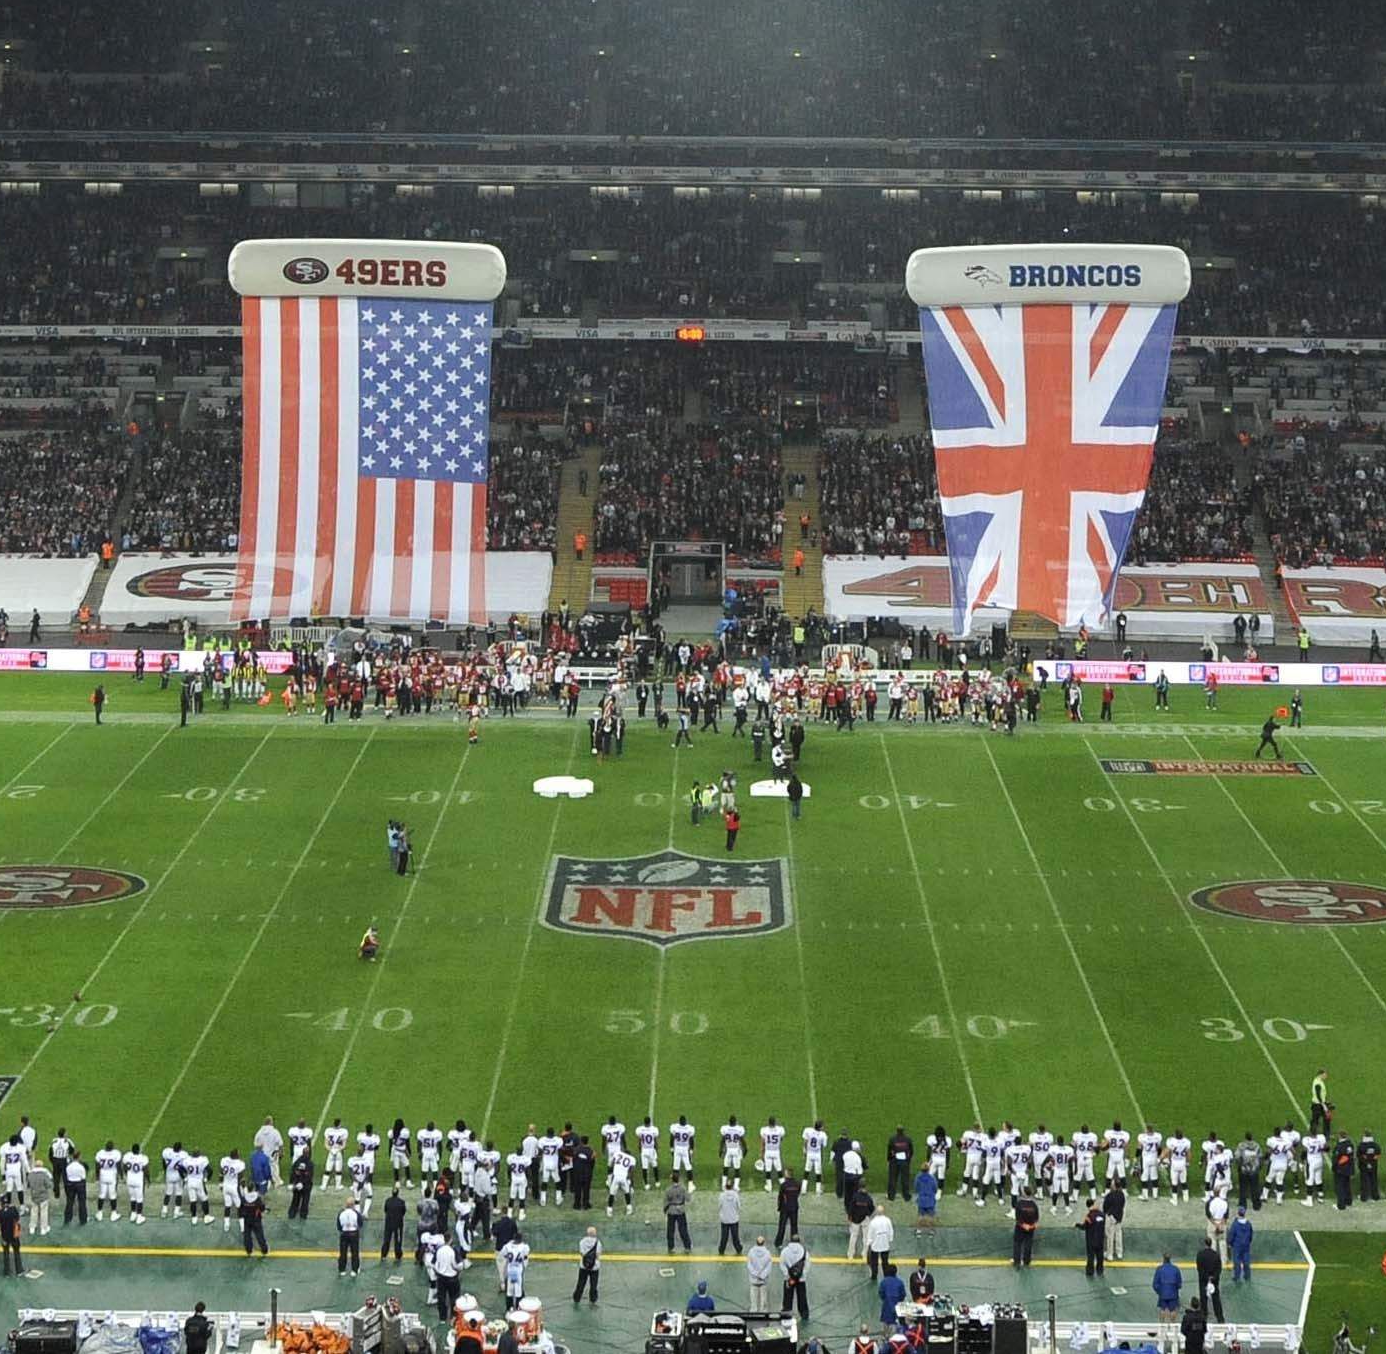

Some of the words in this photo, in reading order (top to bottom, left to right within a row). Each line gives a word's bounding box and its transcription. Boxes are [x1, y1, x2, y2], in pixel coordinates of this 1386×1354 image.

[335, 258, 447, 287] 49ERS
[1008, 264, 1141, 288] BRONCOS
[35, 326, 59, 336] VISA
[576, 329, 599, 338] VISA
[1302, 339, 1326, 349] VISA
[569, 886, 763, 934] NFL
[10, 1004, 119, 1029] 30
[312, 1007, 414, 1033] 40
[604, 1009, 711, 1037] 50
[908, 1013, 1010, 1041] 40
[1200, 1016, 1308, 1044] 30
[328, 1135, 344, 1146] 34
[766, 1134, 779, 1145] 15
[543, 1145, 558, 1156] 57
[1034, 1141, 1049, 1152] 50
[615, 1156, 630, 1167] 20
[1013, 1153, 1028, 1163] 78
[1057, 1154, 1068, 1164] 81
[100, 1159, 114, 1169] 79
[187, 1165, 200, 1174] 91
[511, 1164, 524, 1174] 28
